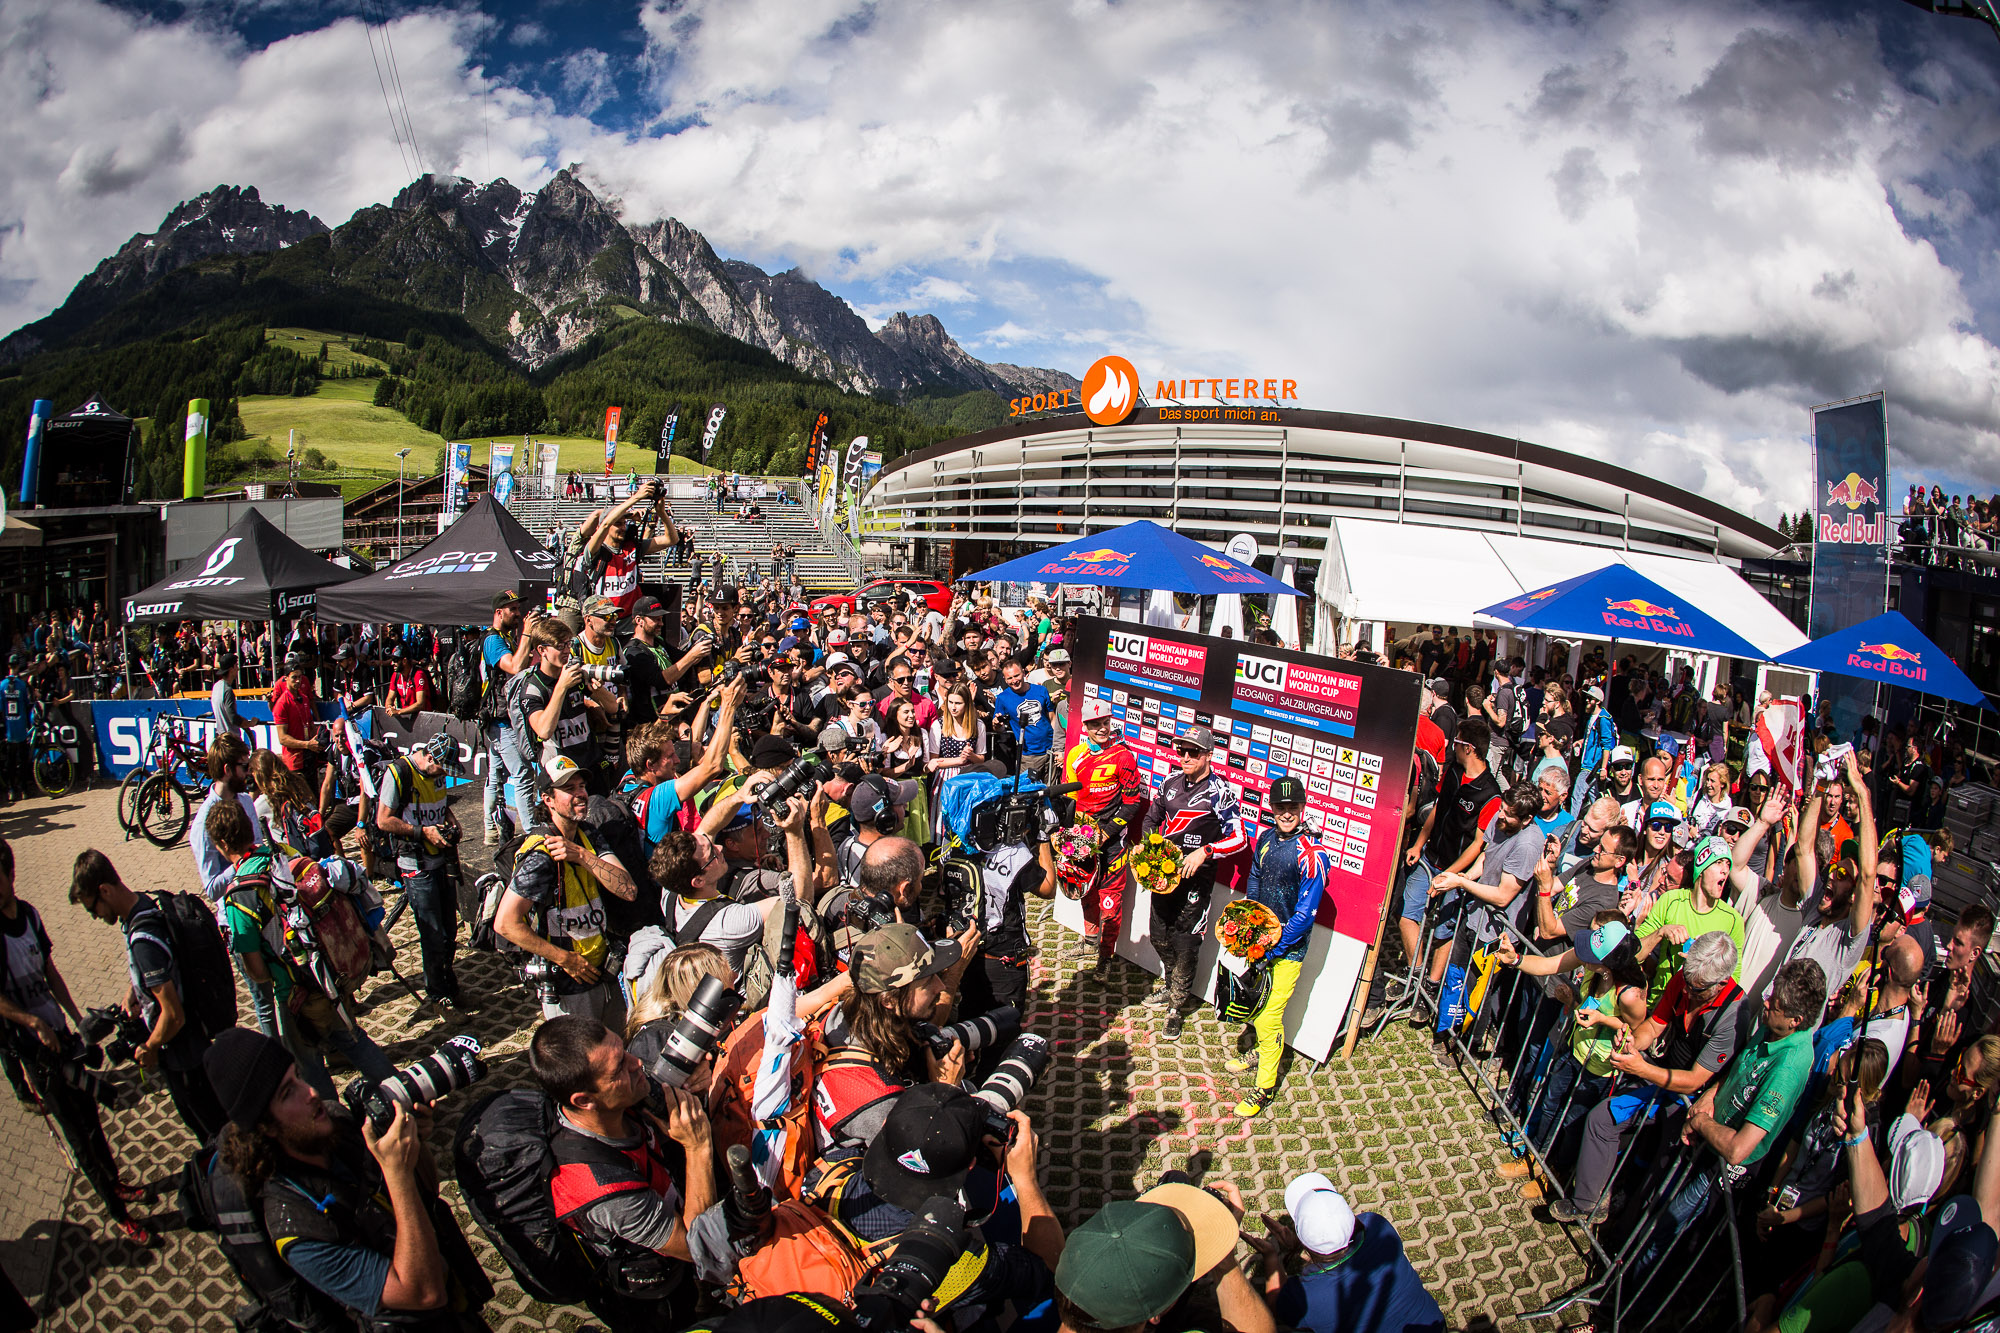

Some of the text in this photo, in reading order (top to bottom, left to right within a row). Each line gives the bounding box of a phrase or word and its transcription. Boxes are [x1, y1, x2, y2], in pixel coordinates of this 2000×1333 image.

[1155, 378, 1299, 400] MITTERER
[1010, 388, 1073, 417] SPORT
[1159, 407, 1282, 422] Das sport mich an.
[659, 414, 673, 459] GoPro
[1819, 511, 1885, 545] Red Bull
[392, 551, 498, 574] GoPro
[1037, 562, 1130, 577] Red Bull
[163, 577, 245, 591] SCOTT
[135, 601, 183, 616] SCOTT
[1602, 612, 1695, 638] Red Bull
[1114, 636, 1145, 657] UCI
[1150, 642, 1204, 660] MOUNTAIN BIKE
[1148, 652, 1189, 667] WORLD CUP
[1847, 653, 1927, 681] Red Bull
[1108, 659, 1199, 686] LEOGANG SALZBURGERLAND
[1245, 660, 1283, 685] UCI
[1290, 669, 1359, 691] MOUNTAIN BIKE
[1288, 680, 1340, 698] WORLD CUP
[1147, 702, 1159, 710] UCI
[1236, 686, 1353, 720] LEOGANG SALZBURGERLAND
[1263, 709, 1288, 720] PRESENTED
[1162, 722, 1174, 730] UCI
[1276, 735, 1291, 745] UCI
[1319, 746, 1334, 756] UCI
[1295, 757, 1309, 768] UCI
[1365, 758, 1381, 768] UCI
[1338, 770, 1354, 781] UCI
[1089, 783, 1118, 793] SRAM
[1313, 781, 1328, 792] UCI
[1359, 793, 1375, 805] UCI
[1331, 818, 1346, 829] UCI
[1350, 842, 1366, 854] UCI
